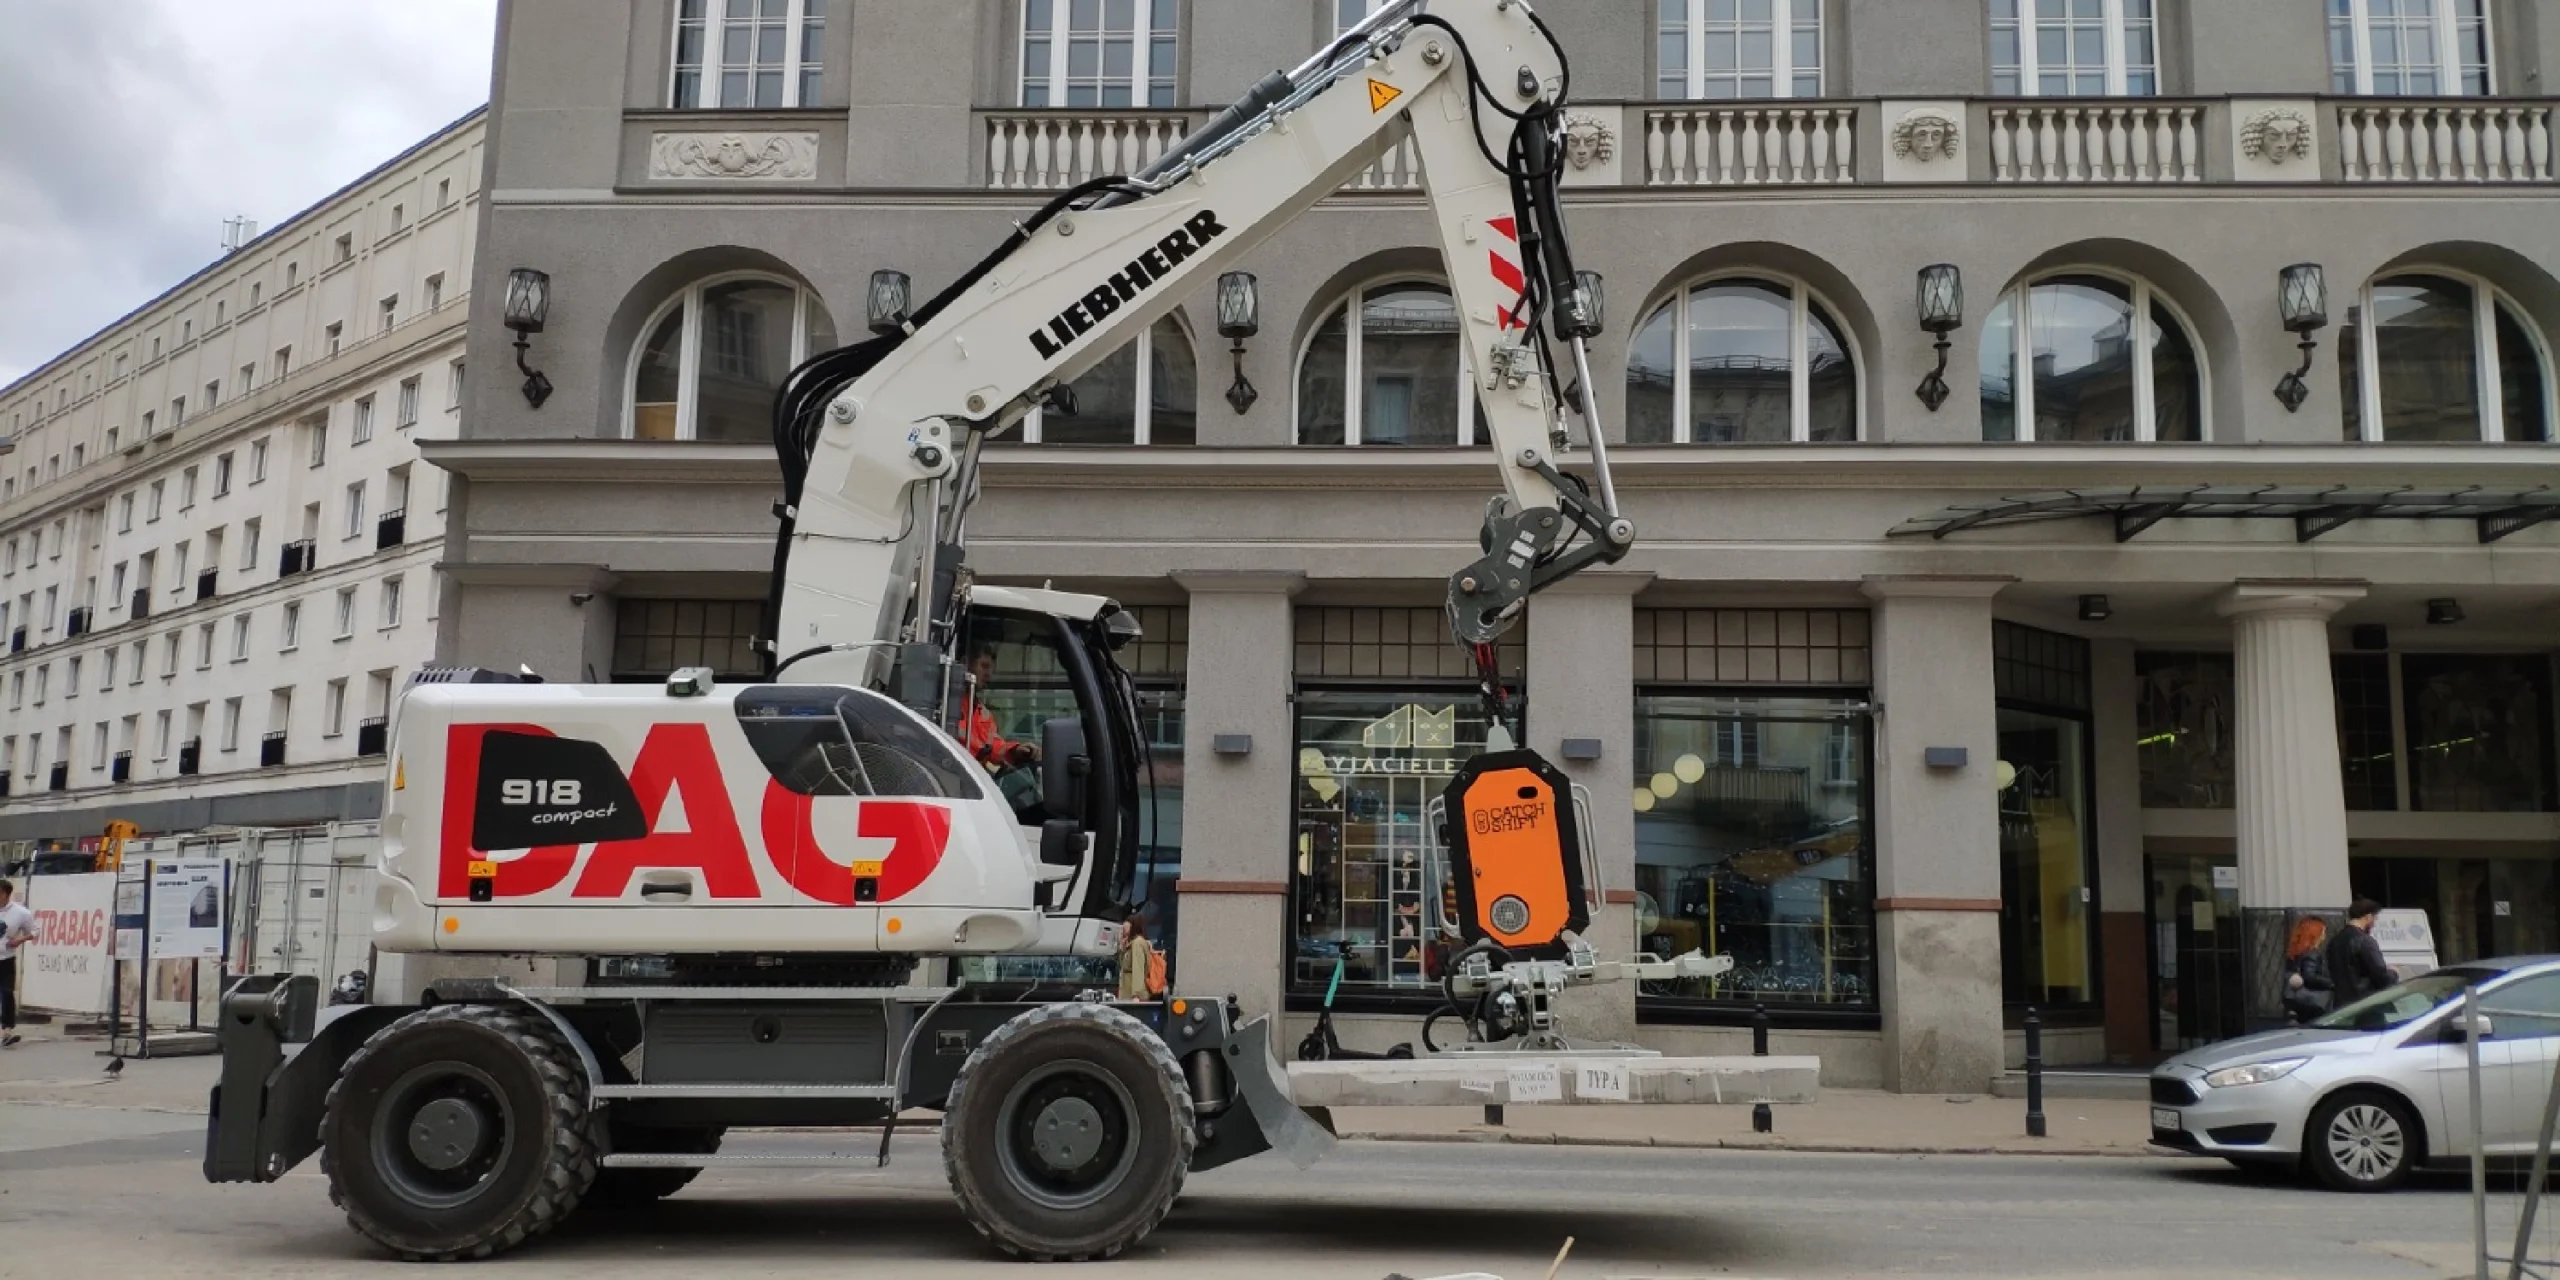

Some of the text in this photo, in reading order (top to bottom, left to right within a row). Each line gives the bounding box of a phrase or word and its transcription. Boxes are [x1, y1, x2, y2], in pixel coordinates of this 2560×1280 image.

[1028, 209, 1228, 361] LIEBHERR
[501, 778, 582, 806] 918
[532, 801, 618, 824] compact
[1490, 802, 1545, 820] CATCH
[1491, 815, 1535, 833] SHIFT
[31, 908, 104, 948] STRABAG
[1586, 1069, 1620, 1091] TYP A
